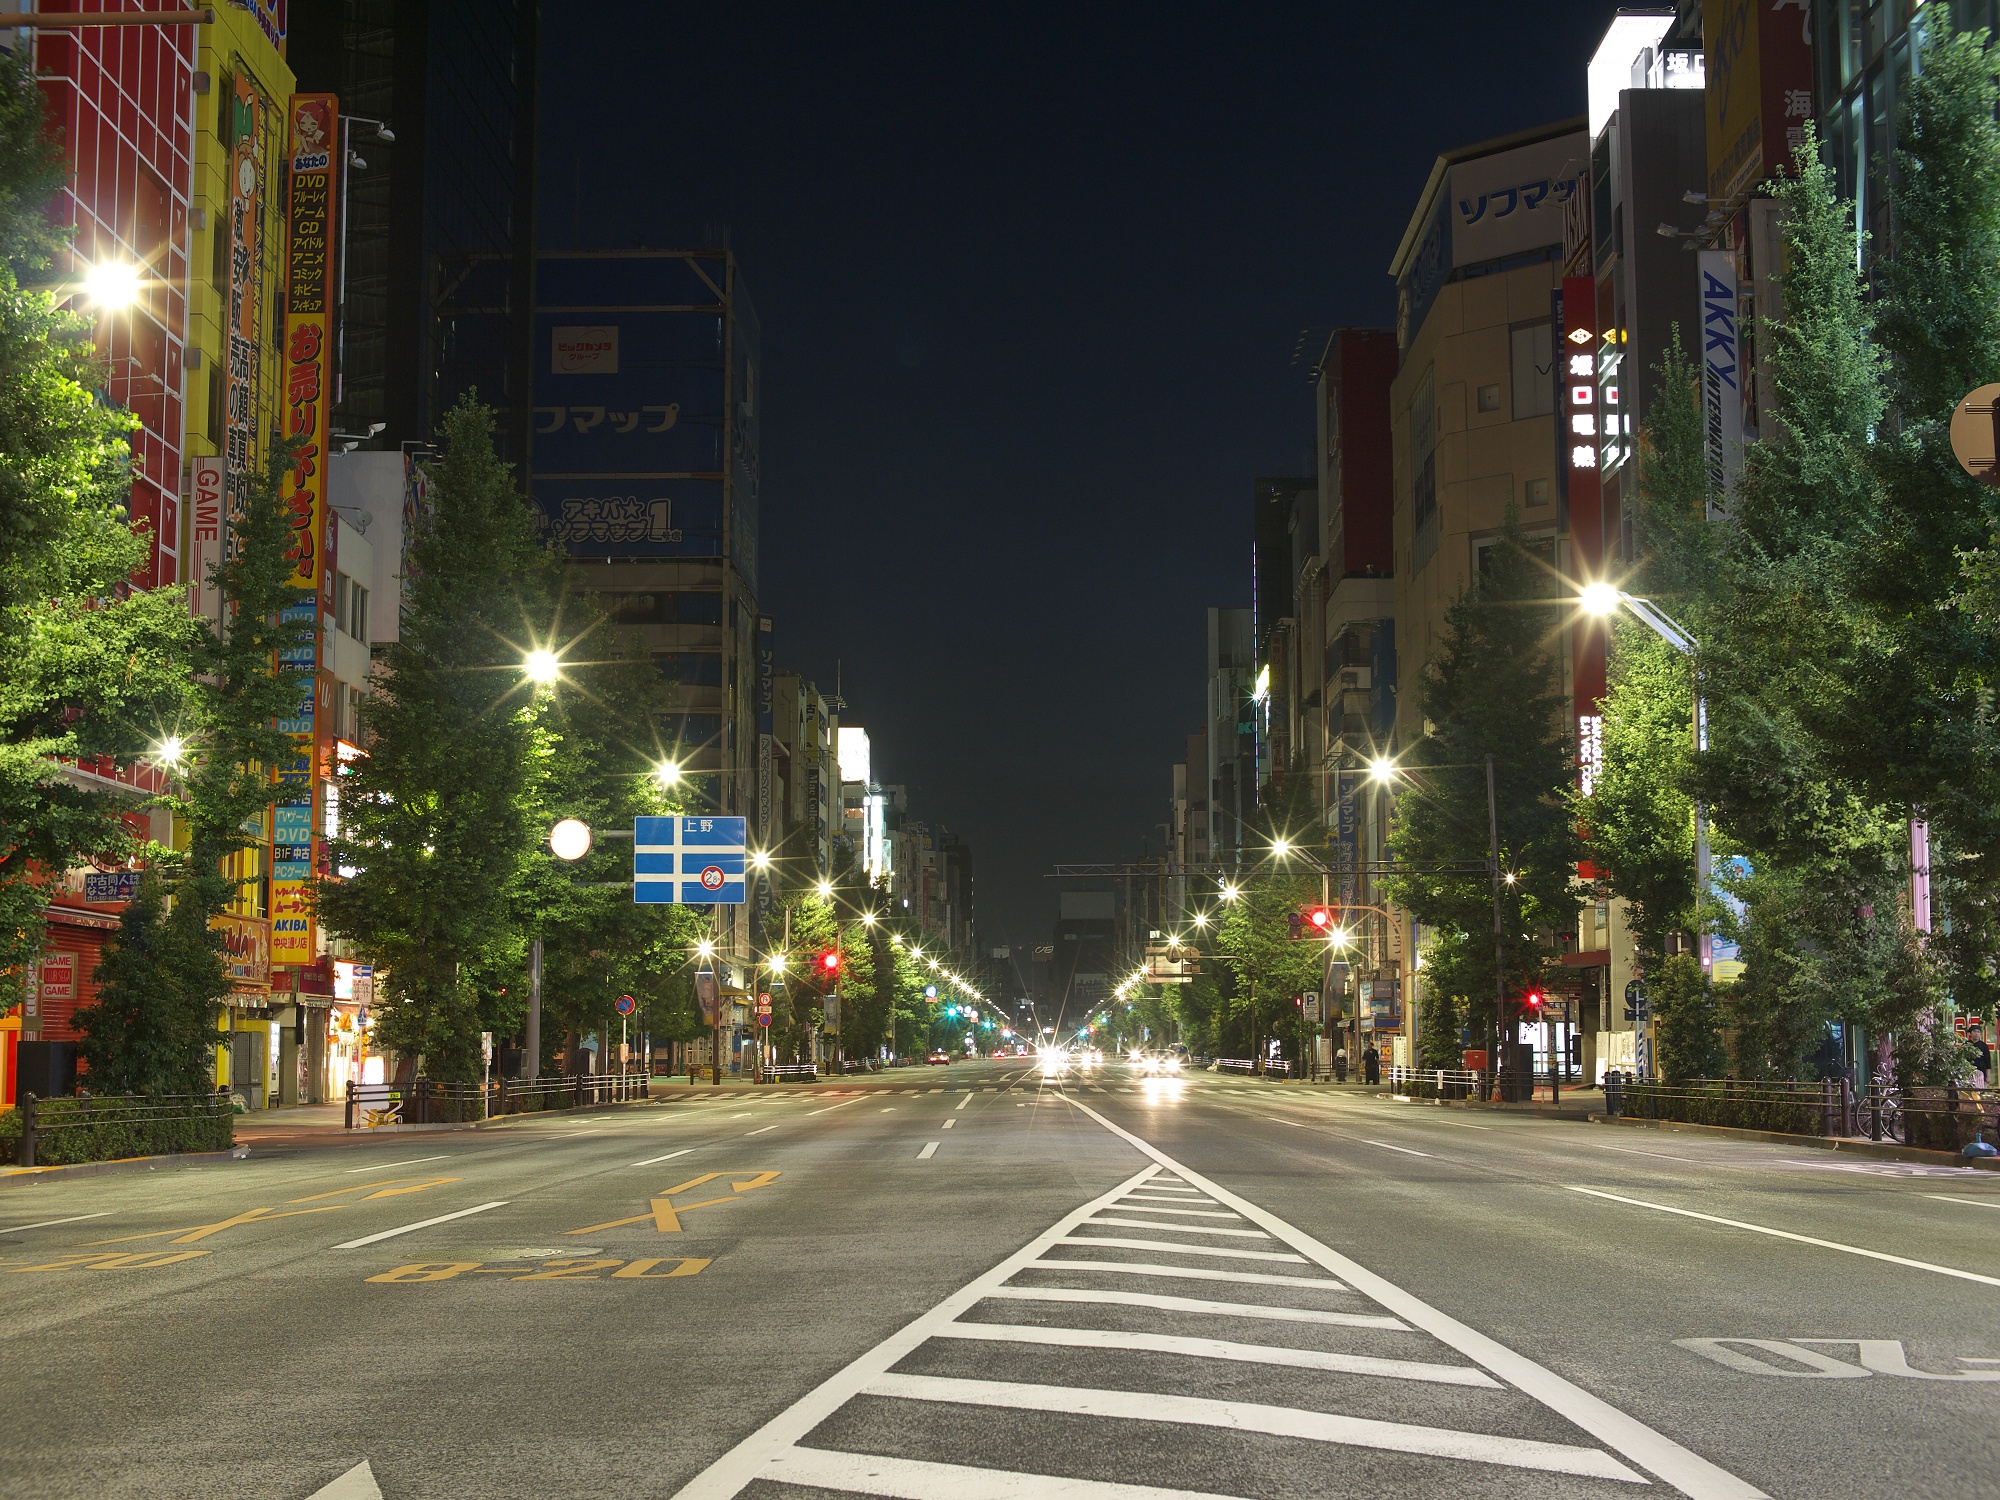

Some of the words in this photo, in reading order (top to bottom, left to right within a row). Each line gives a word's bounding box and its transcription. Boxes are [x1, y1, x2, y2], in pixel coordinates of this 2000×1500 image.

[294, 155, 327, 170] あなたの
[295, 175, 325, 188] DVD
[293, 191, 327, 203] ブルーレイ
[1459, 170, 1585, 225] ソフマッ
[294, 206, 325, 218] ゲーム
[299, 222, 320, 235] CD
[293, 237, 324, 249] アイドル
[293, 253, 325, 265] アニメ
[293, 268, 322, 280] コミック
[293, 284, 322, 296] ホビー
[292, 300, 322, 312] フィギュア
[1703, 270, 1737, 390] AKKY
[558, 342, 612, 352] ビックカメラ
[569, 352, 600, 361] グループ
[194, 469, 220, 542] GAME
[281, 648, 313, 660] DVD
[279, 721, 311, 733] DVD
[276, 810, 310, 823] TVゲーム
[684, 819, 713, 833] 上野
[276, 828, 309, 842] DVD
[274, 845, 292, 859] B1F
[293, 847, 310, 860] 中古
[274, 866, 309, 878] PCゲーム
[87, 874, 141, 887] 中古同人誌
[274, 901, 307, 913] ムーラン
[273, 919, 308, 931] AKIBA
[273, 937, 307, 949] 中央通り店
[45, 957, 71, 966] GAME
[44, 986, 70, 996] GAME
[1306, 994, 1315, 1006] P
[363, 1258, 713, 1283] 8-20
